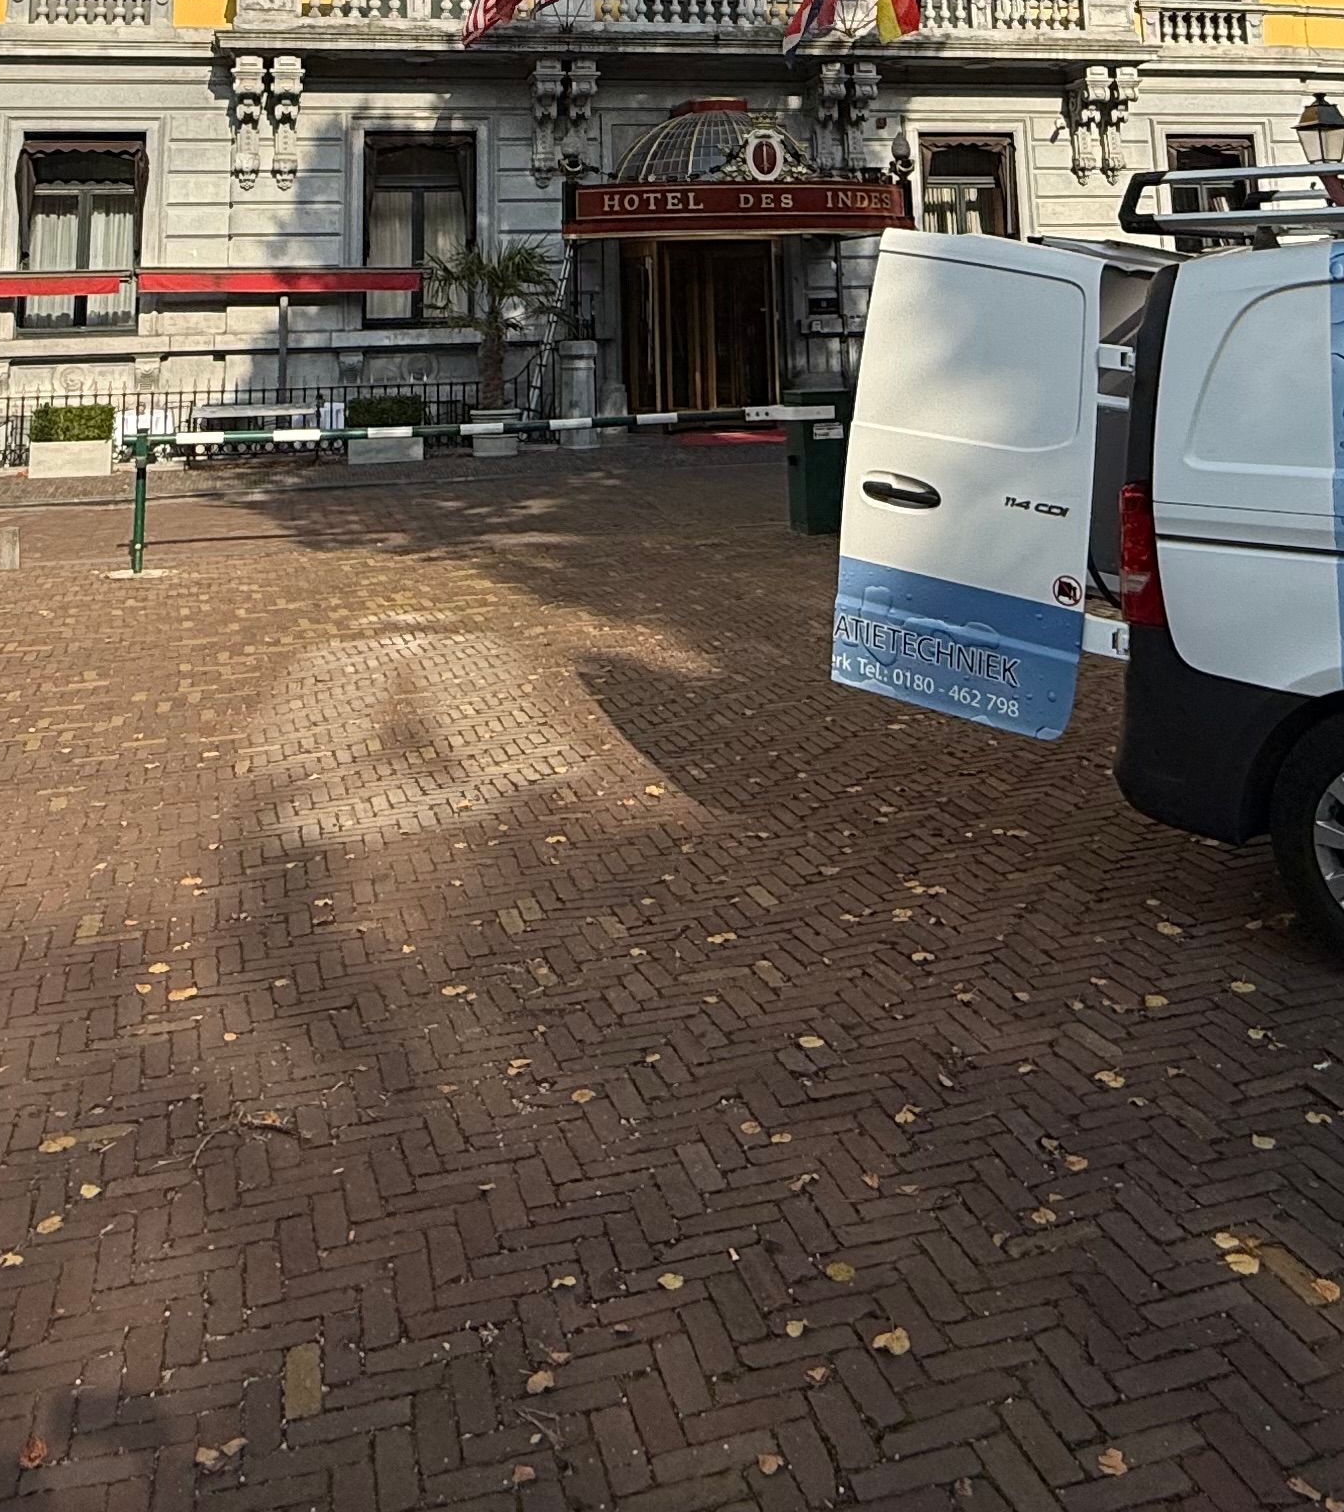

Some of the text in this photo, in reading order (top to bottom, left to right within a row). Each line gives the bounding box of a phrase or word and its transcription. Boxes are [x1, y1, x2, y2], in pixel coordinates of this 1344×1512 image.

[603, 190, 892, 211] HOTEL DES INDES
[1004, 496, 1070, 518] 114 CDI
[834, 615, 1021, 688] ATIETECHNIEK
[857, 657, 888, 682] Tel.:
[892, 668, 934, 695] 0180
[948, 685, 982, 709] 462
[986, 693, 1020, 718] 798
